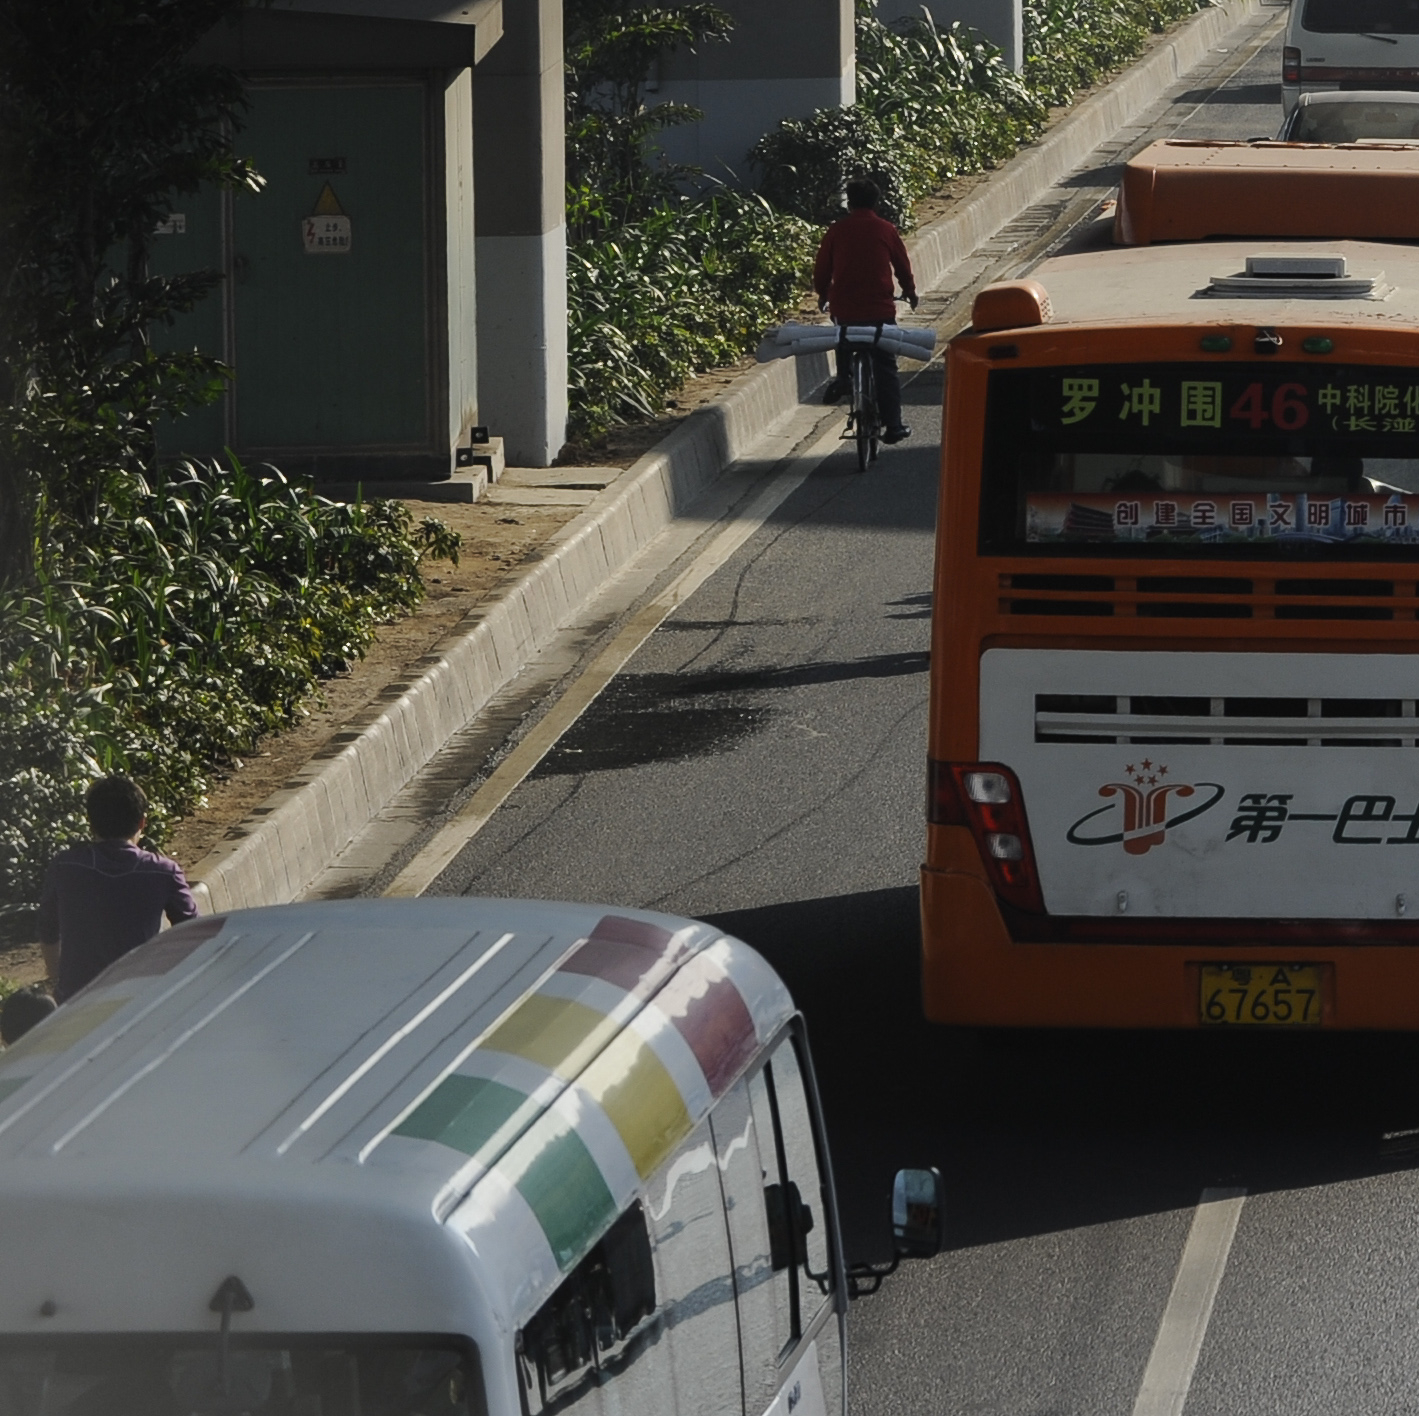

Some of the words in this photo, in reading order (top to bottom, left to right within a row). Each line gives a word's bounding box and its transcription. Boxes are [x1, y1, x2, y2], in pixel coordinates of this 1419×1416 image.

[1060, 378, 1223, 428] 罗冲围
[1230, 382, 1310, 430] 46
[1115, 501, 1408, 527] 创建全国文明城市
[1205, 988, 1316, 1022] 67657
